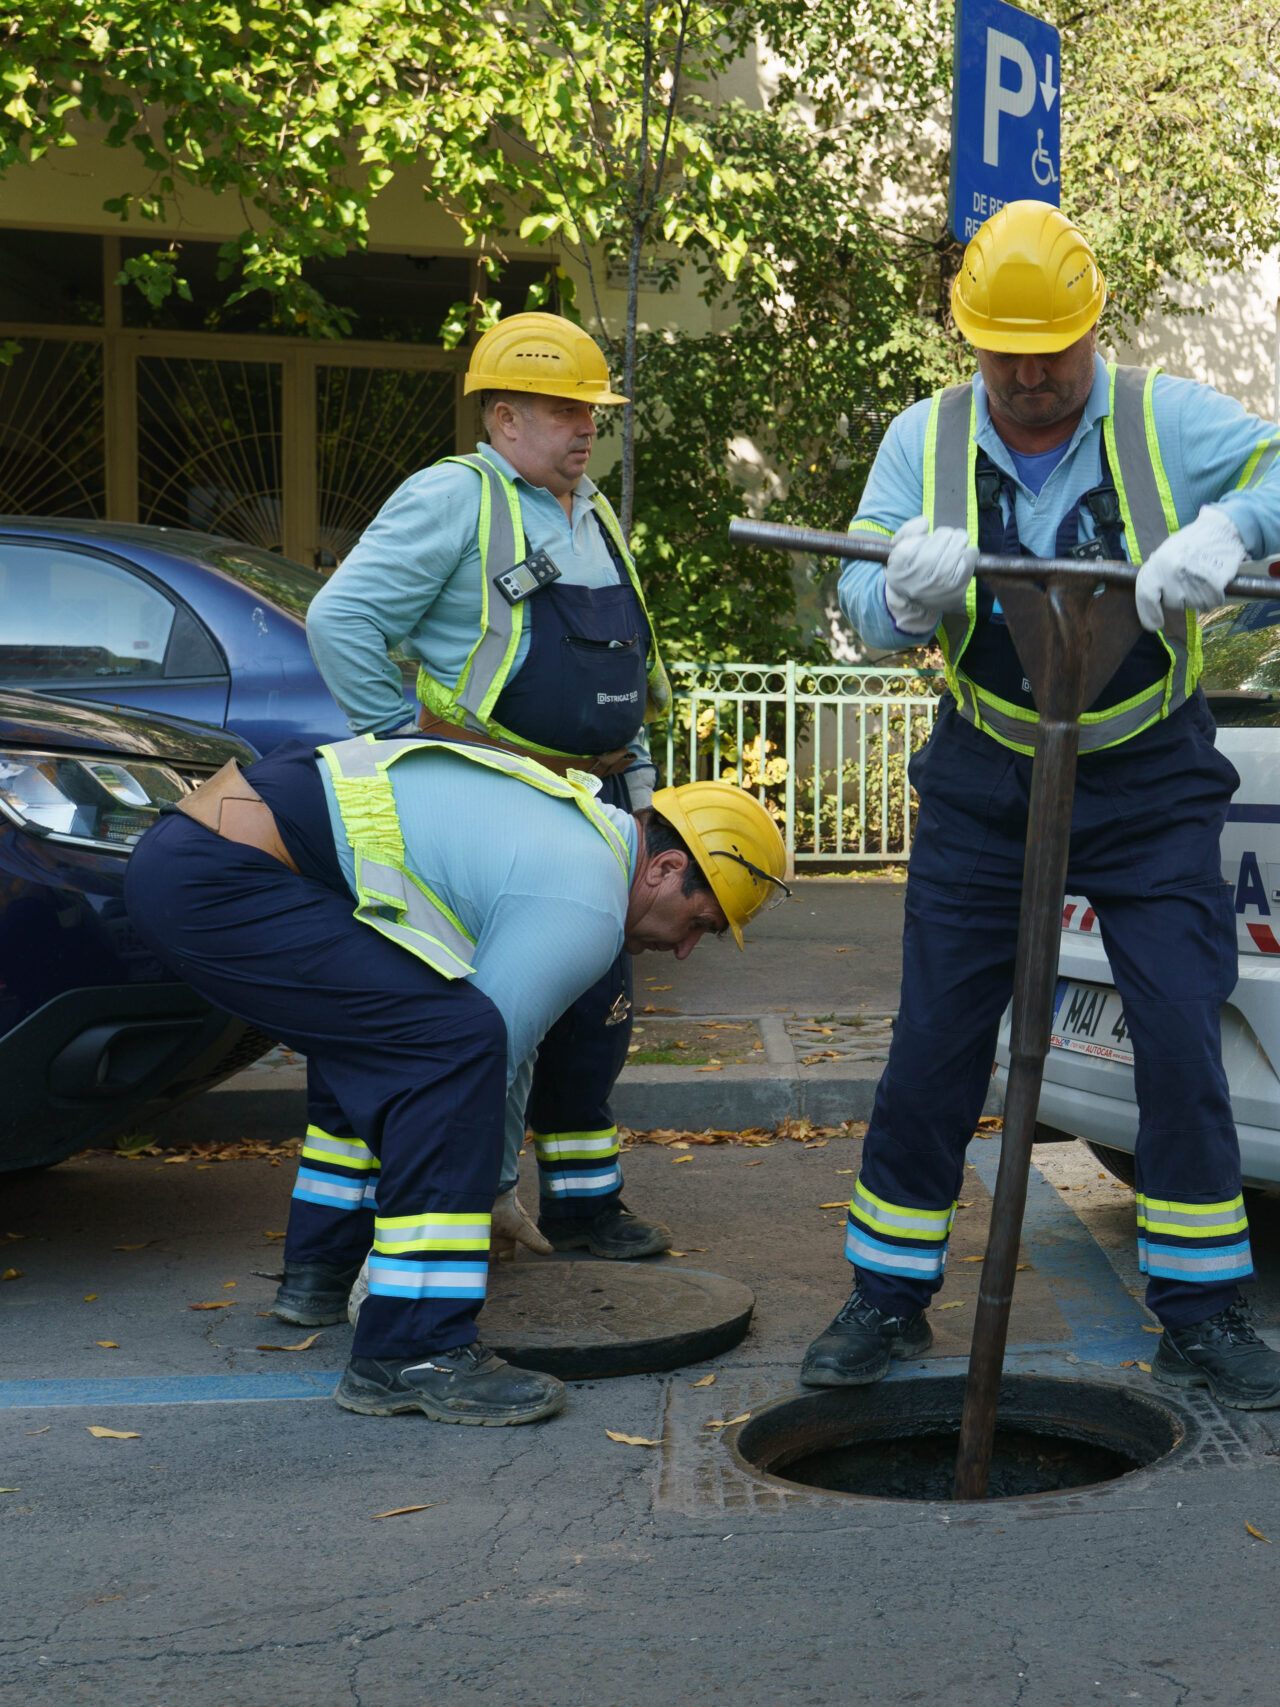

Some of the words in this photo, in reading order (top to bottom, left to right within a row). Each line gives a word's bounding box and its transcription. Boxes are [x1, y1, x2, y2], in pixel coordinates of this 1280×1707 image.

[983, 26, 1037, 168] P
[973, 191, 988, 216] DE
[989, 196, 1008, 217] RE
[965, 216, 984, 238] RE
[1062, 988, 1108, 1038] MAI
[1111, 1010, 1133, 1043] 4
[1085, 1044, 1113, 1058] AUTOCAR
